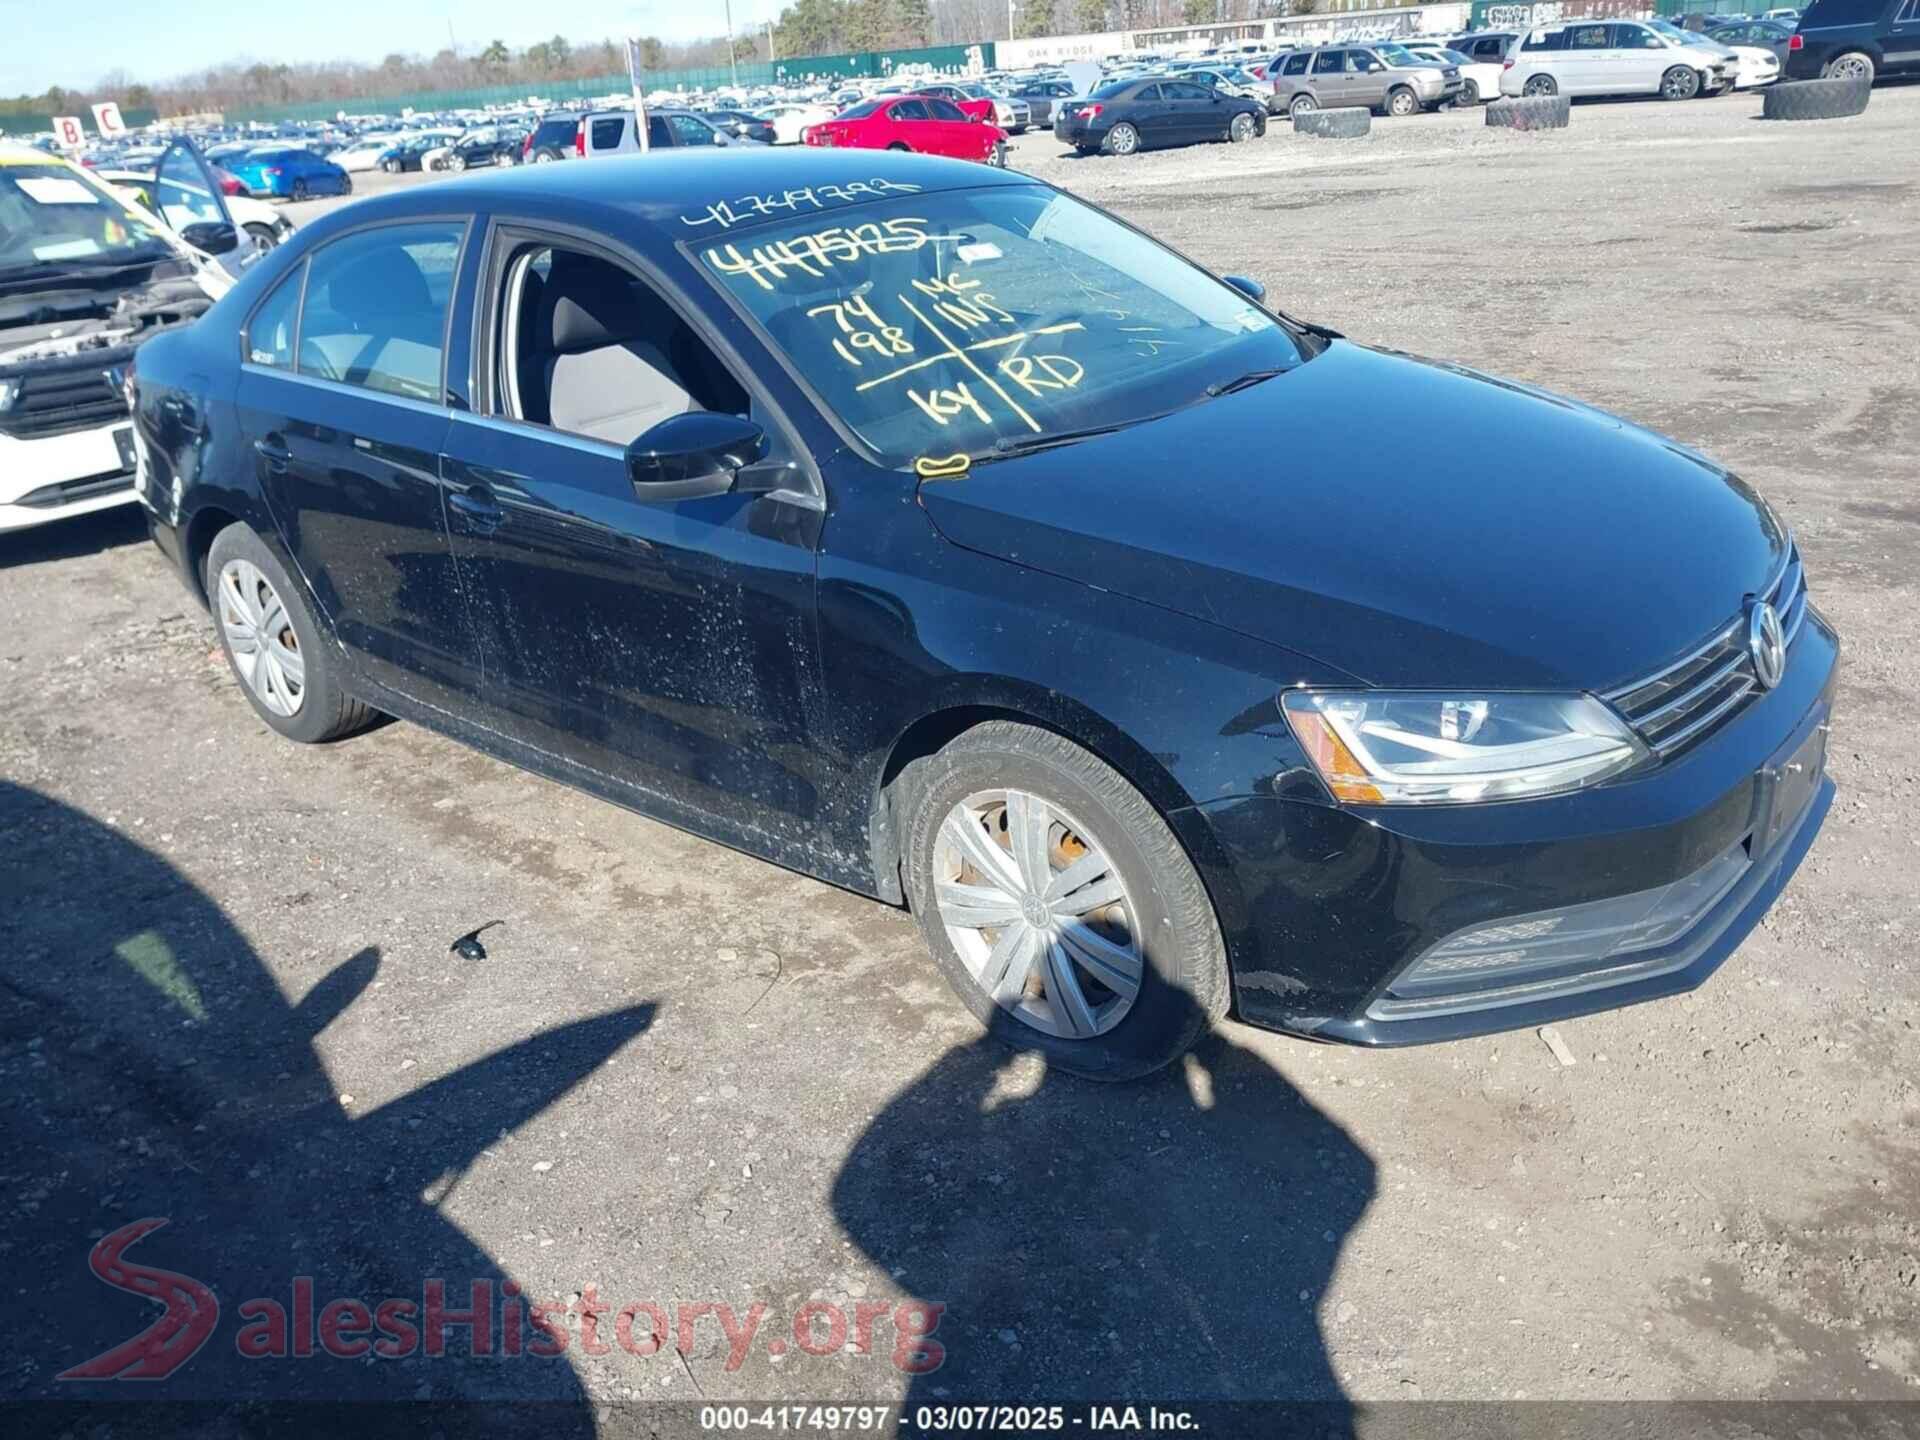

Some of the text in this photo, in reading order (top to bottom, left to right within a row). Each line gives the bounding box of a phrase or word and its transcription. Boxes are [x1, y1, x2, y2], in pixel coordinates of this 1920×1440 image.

[62, 119, 79, 144] B
[101, 108, 119, 131] C
[832, 326, 915, 366] 198
[998, 354, 1084, 397] RD
[906, 381, 992, 425] KY
